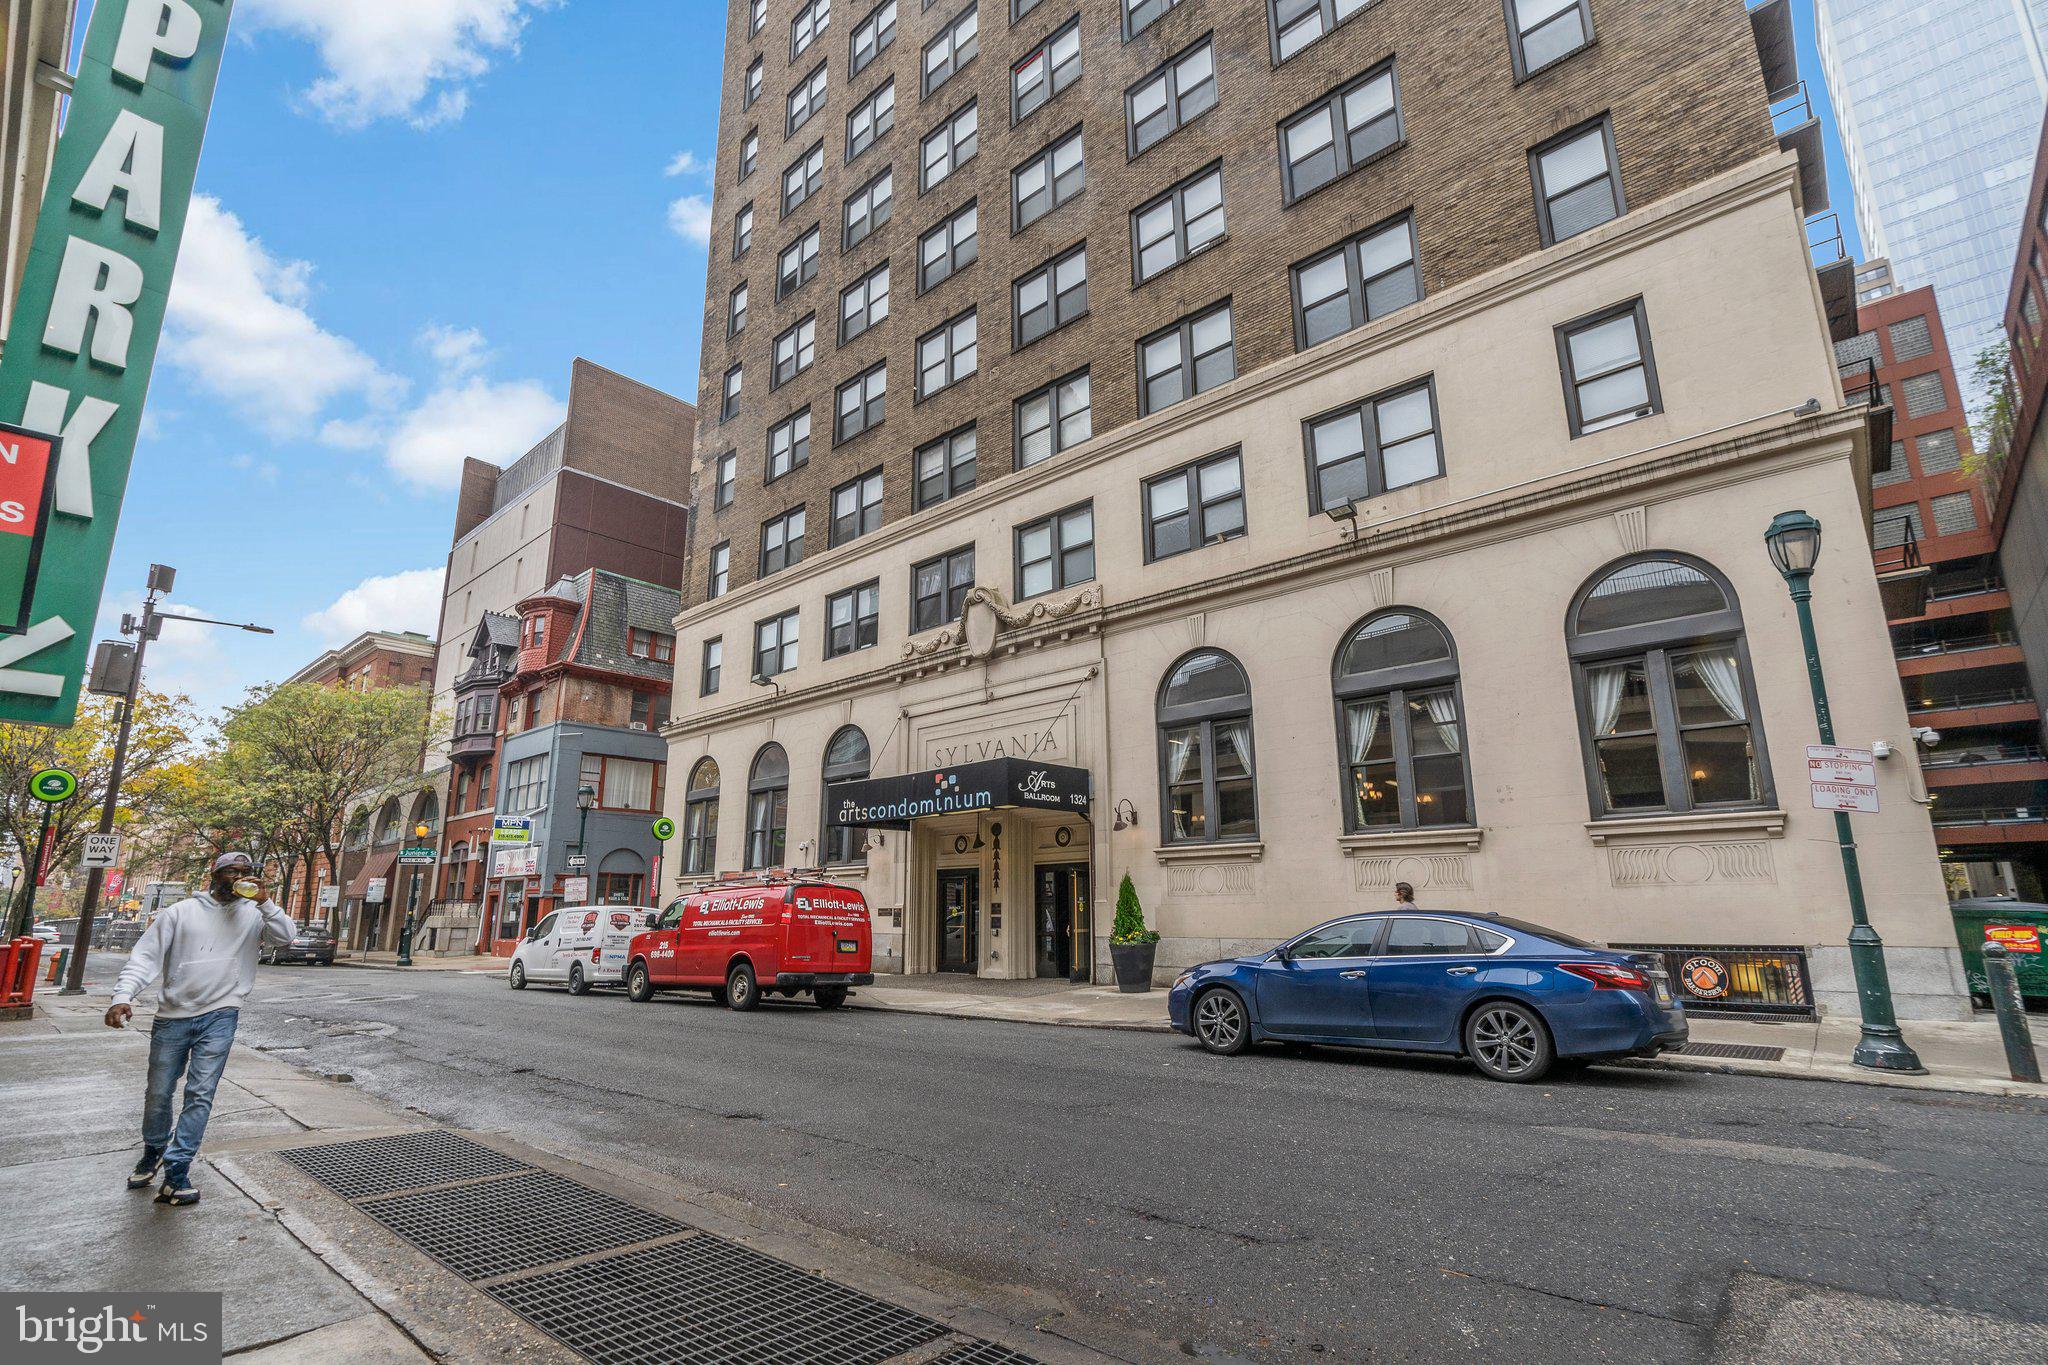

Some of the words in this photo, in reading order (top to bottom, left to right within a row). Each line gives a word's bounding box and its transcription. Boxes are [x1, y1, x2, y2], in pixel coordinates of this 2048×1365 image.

[21, 0, 202, 522] PARK
[935, 730, 1058, 768] SYLVANIA
[1809, 760, 1821, 768] NO
[1824, 761, 1863, 771] STOPPING
[1815, 784, 1851, 795] LOADING
[1855, 787, 1874, 797] ONLY
[1024, 792, 1061, 803] BALLROOM
[1069, 793, 1087, 805] 1324
[843, 800, 856, 809] the
[501, 819, 522, 828] MPN
[90, 836, 118, 845] ONE
[89, 845, 116, 854] WAY
[711, 897, 765, 912] Elliott-Lewis
[813, 898, 865, 912] Elliott-Lewis
[659, 941, 669, 950] 215
[1685, 959, 1724, 976] groom
[1684, 977, 1723, 997] BARBERSHOP
